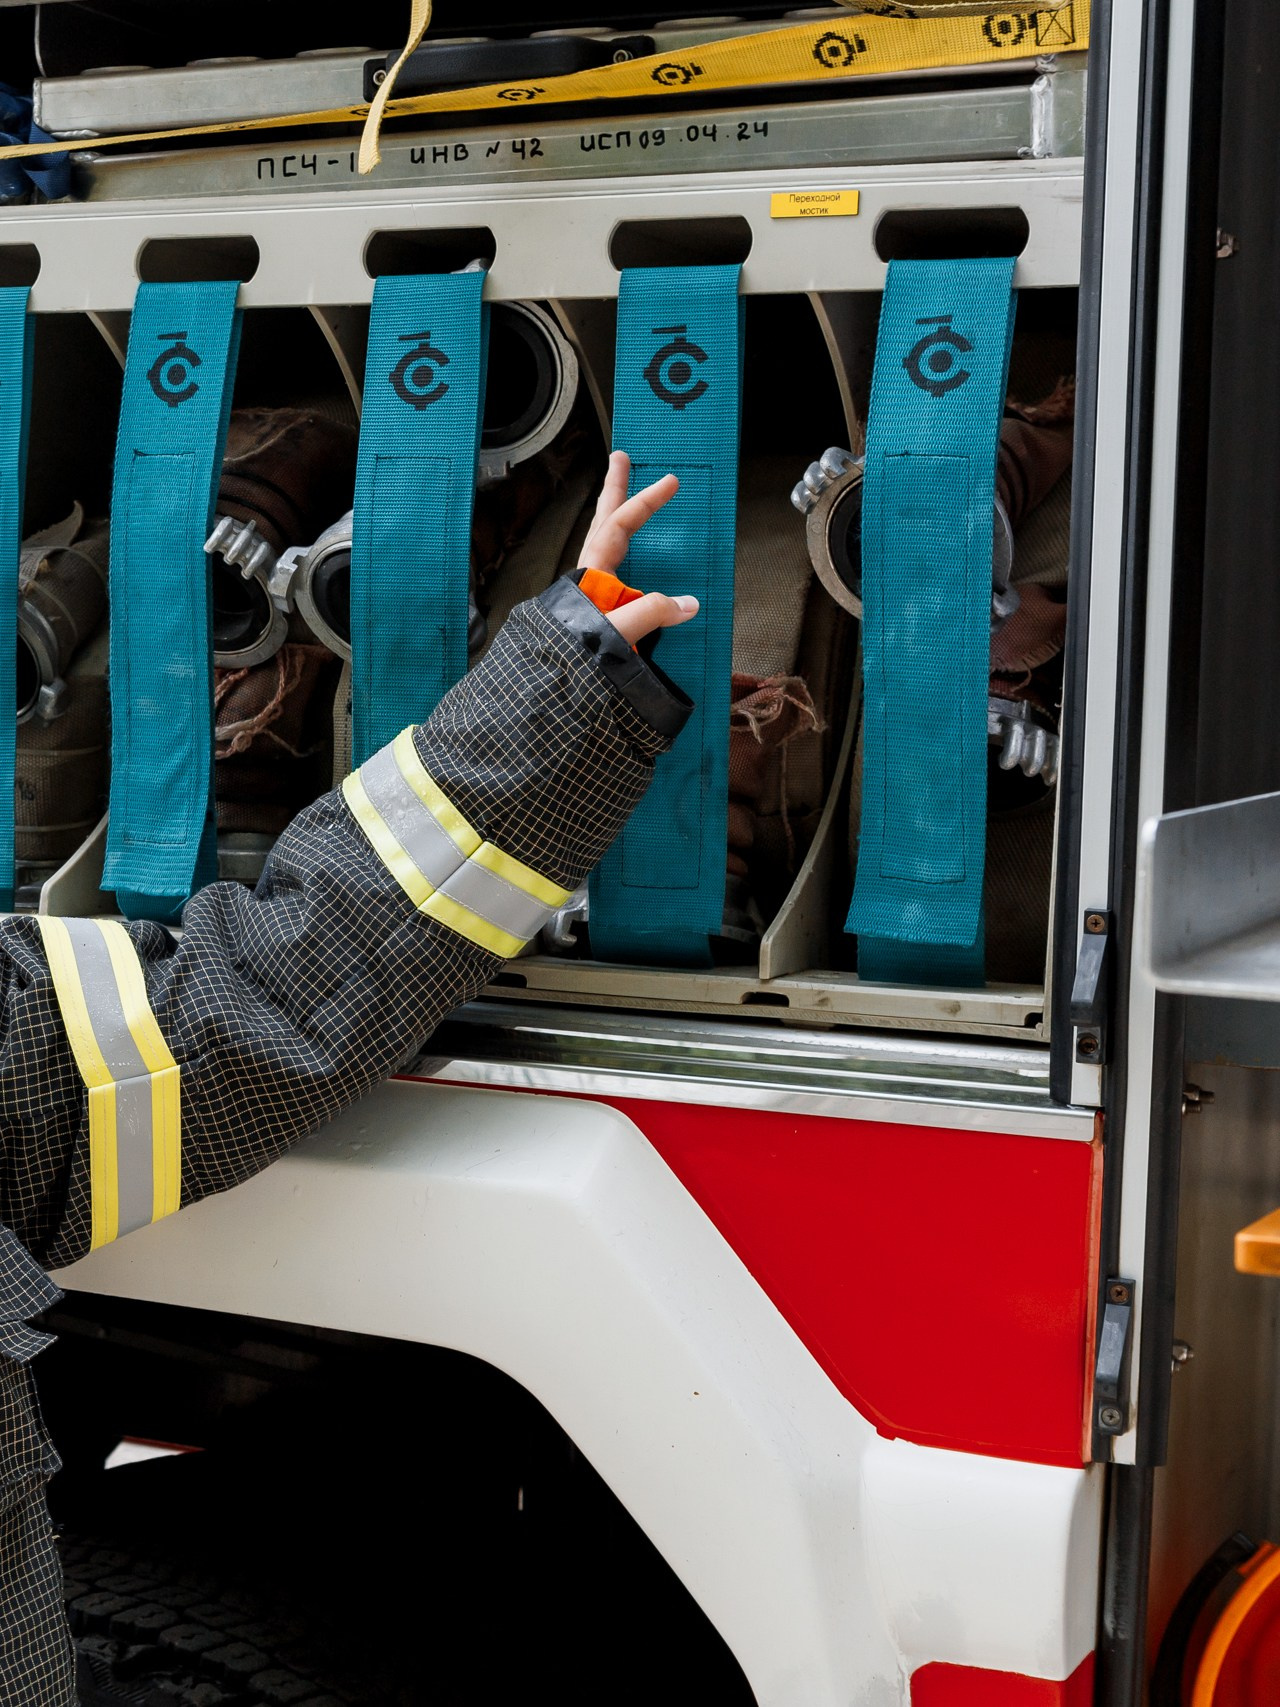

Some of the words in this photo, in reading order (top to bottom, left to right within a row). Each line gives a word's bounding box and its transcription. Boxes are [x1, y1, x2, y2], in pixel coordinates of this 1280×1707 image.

[410, 143, 469, 164] ИНВ
[511, 138, 544, 160] 42
[580, 131, 631, 151] ИСП
[789, 193, 841, 204] Переходной
